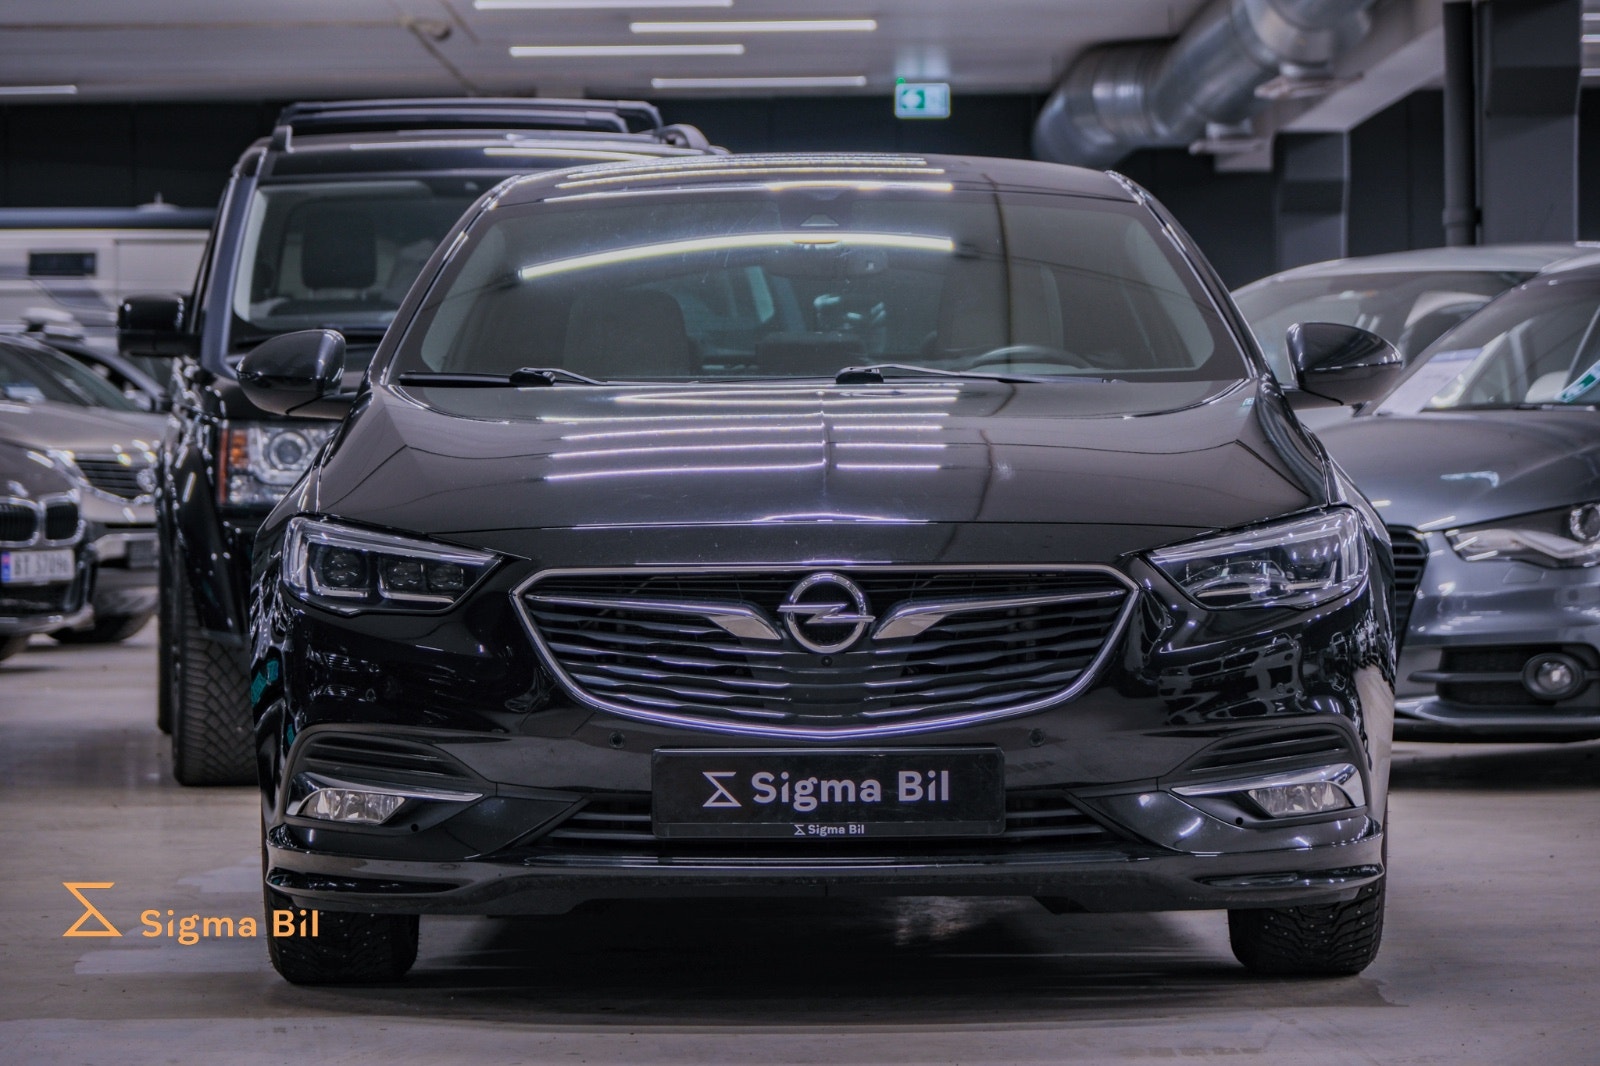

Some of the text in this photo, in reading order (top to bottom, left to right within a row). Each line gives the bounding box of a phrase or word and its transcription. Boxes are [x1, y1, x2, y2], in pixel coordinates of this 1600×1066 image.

[752, 770, 949, 811] Sigma Bil
[808, 822, 865, 837] Sigma Bil
